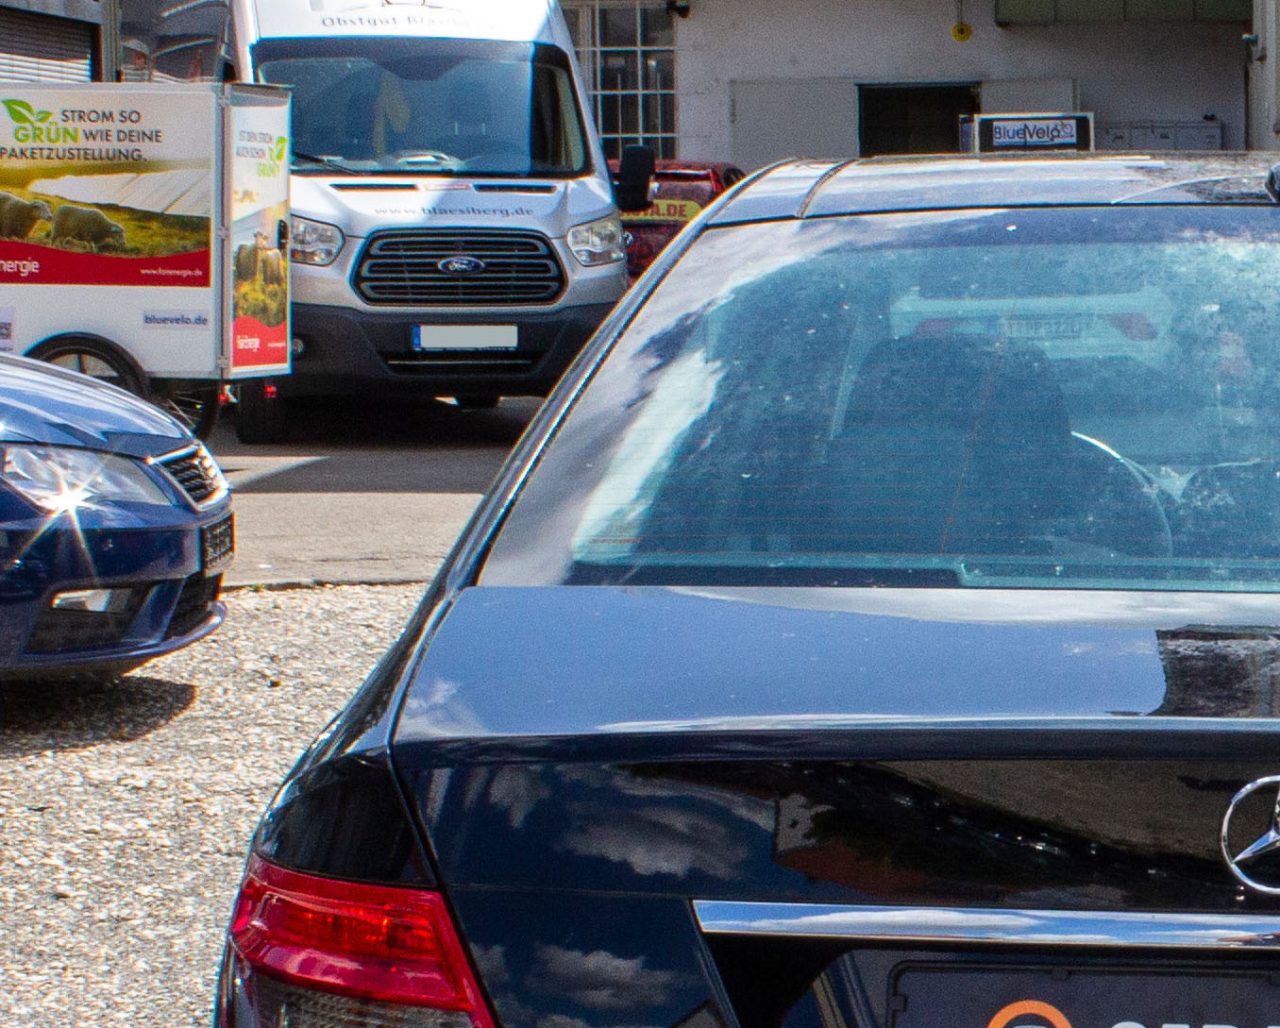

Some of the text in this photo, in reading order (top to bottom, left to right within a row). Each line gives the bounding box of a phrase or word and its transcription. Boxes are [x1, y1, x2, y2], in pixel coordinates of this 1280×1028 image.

[62, 109, 142, 123] STROM SO
[15, 122, 162, 144] GRÜN WIE DEINE
[0, 147, 147, 161] PAKETZUSTELLUNG.
[144, 314, 208, 325] bluevelo.de
